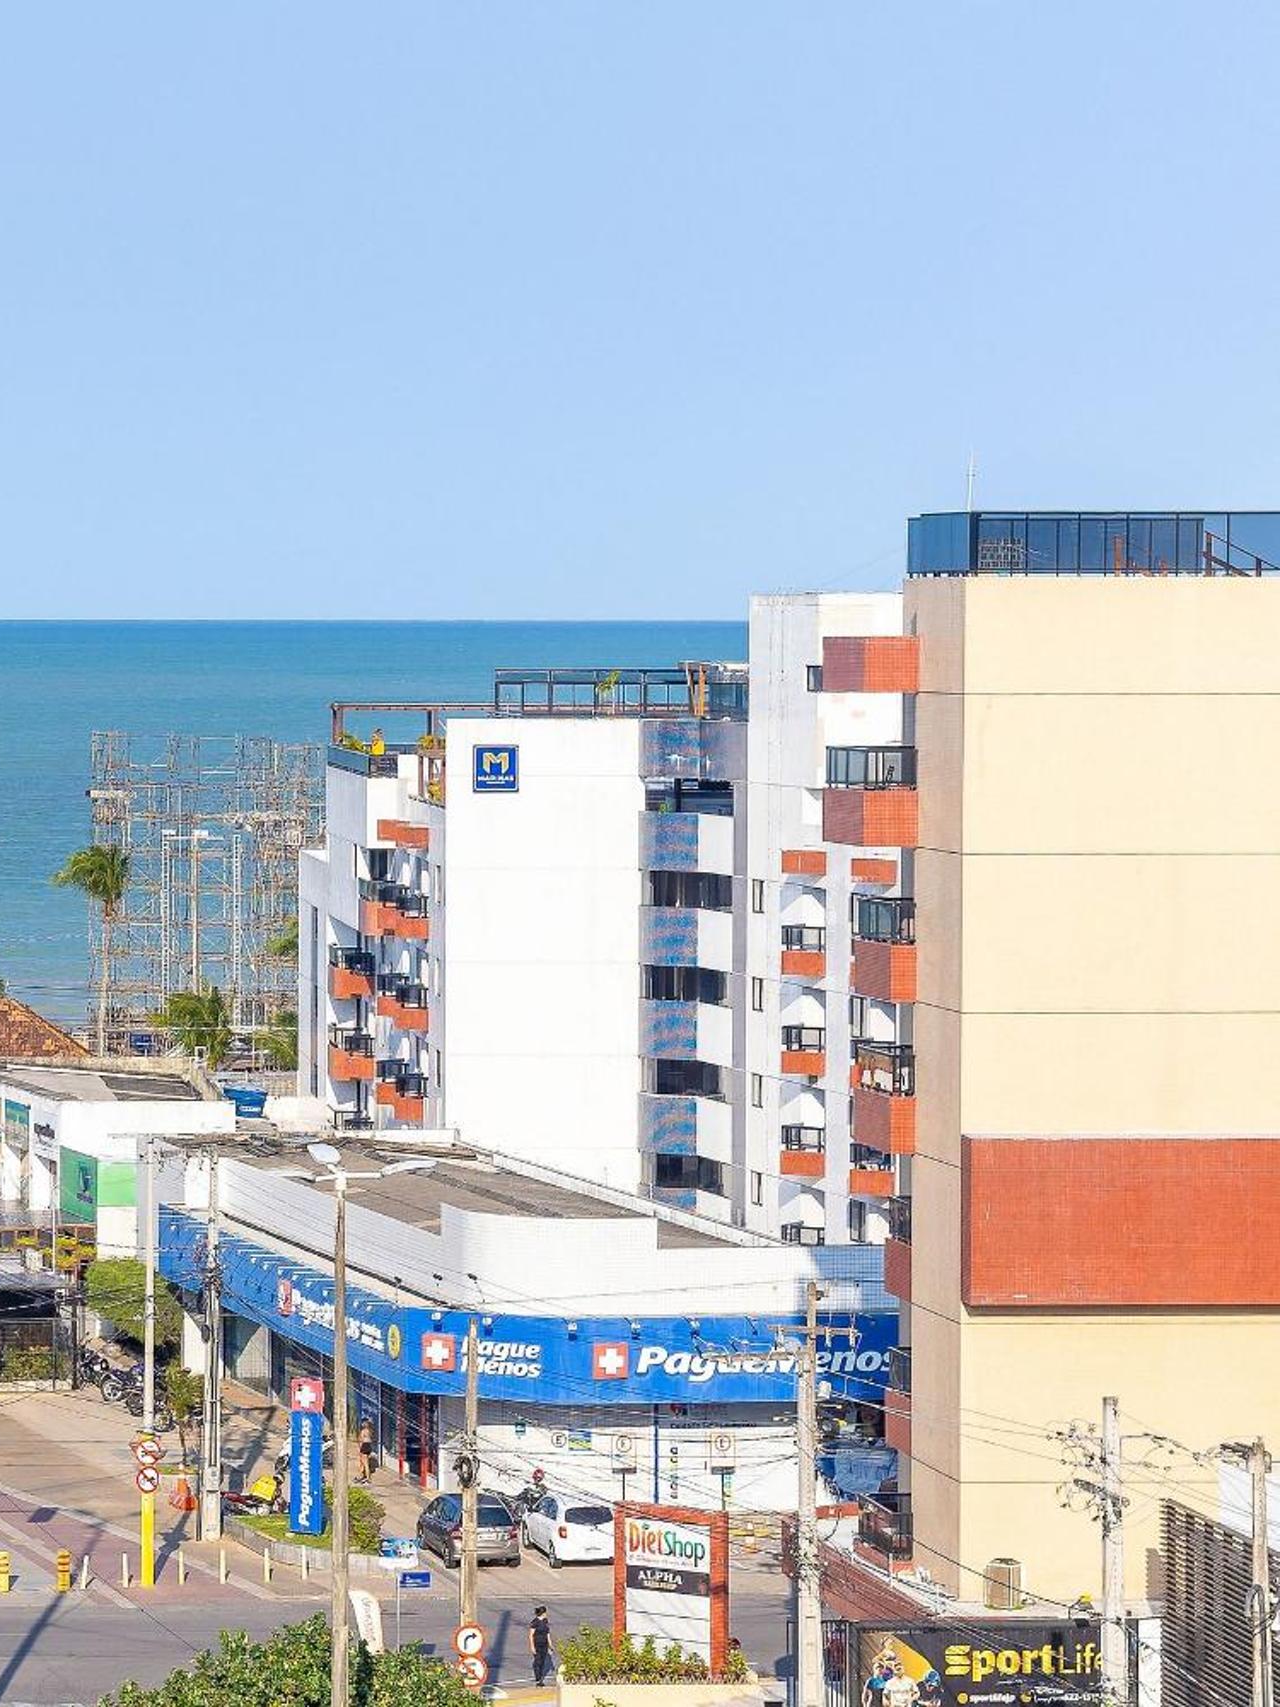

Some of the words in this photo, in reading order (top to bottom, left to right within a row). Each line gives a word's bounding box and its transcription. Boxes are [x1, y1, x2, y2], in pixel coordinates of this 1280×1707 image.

[298, 1418, 313, 1527] PagueMenos
[629, 1522, 706, 1567] DietShop
[638, 1570, 683, 1585] ALPHA
